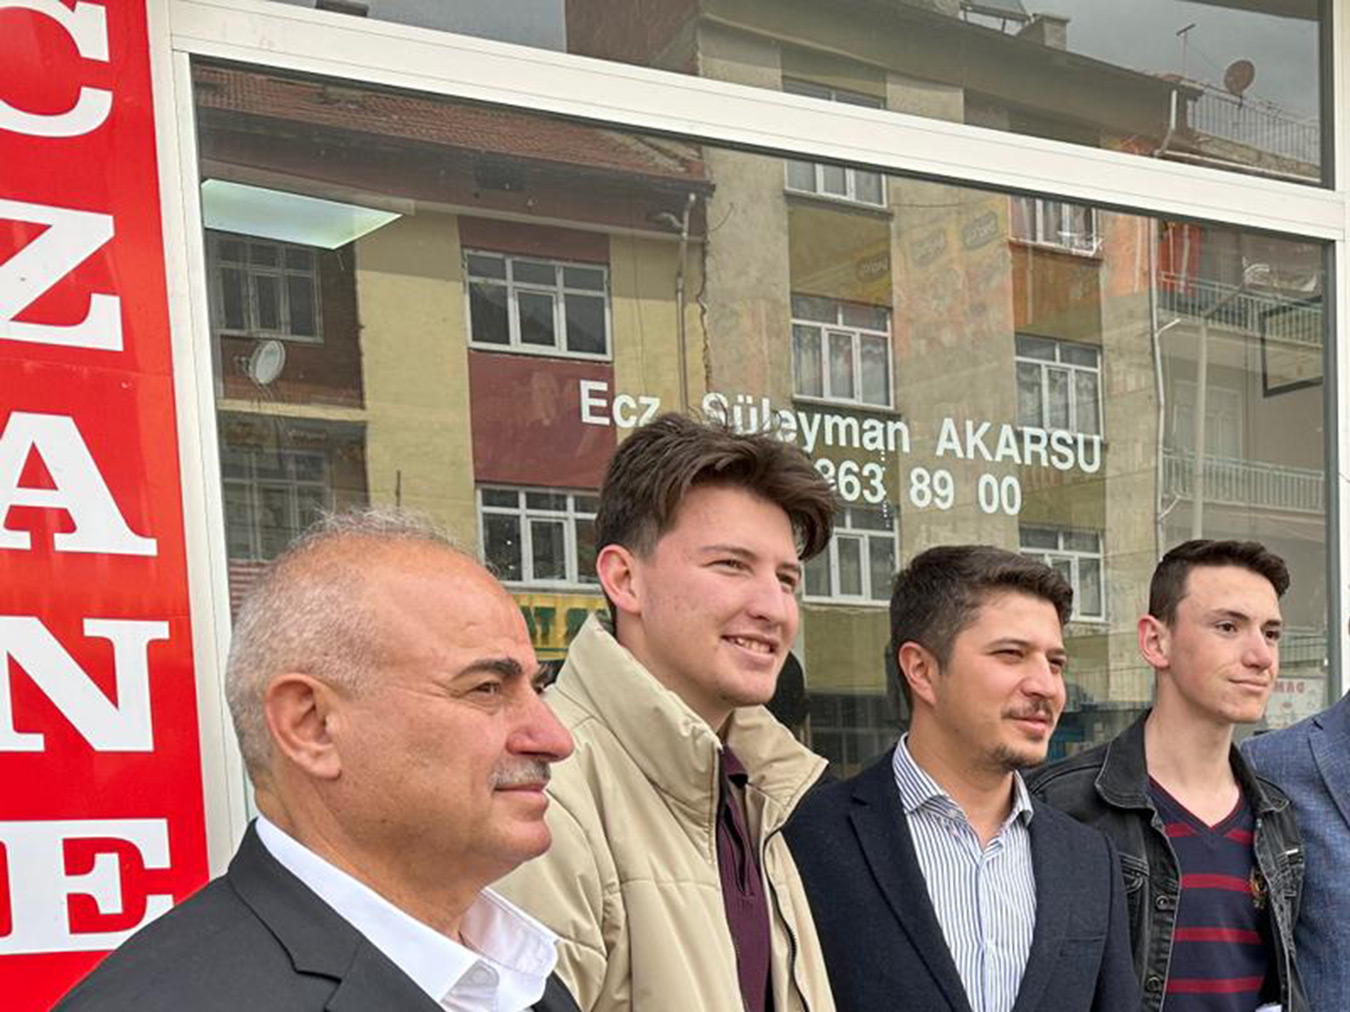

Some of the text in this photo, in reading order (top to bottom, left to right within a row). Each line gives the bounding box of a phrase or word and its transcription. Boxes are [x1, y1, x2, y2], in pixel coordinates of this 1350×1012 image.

[702, 391, 910, 454] Süleyman
[935, 418, 1101, 474] AKARSU
[909, 466, 955, 510] 89
[978, 473, 1022, 515] 00
